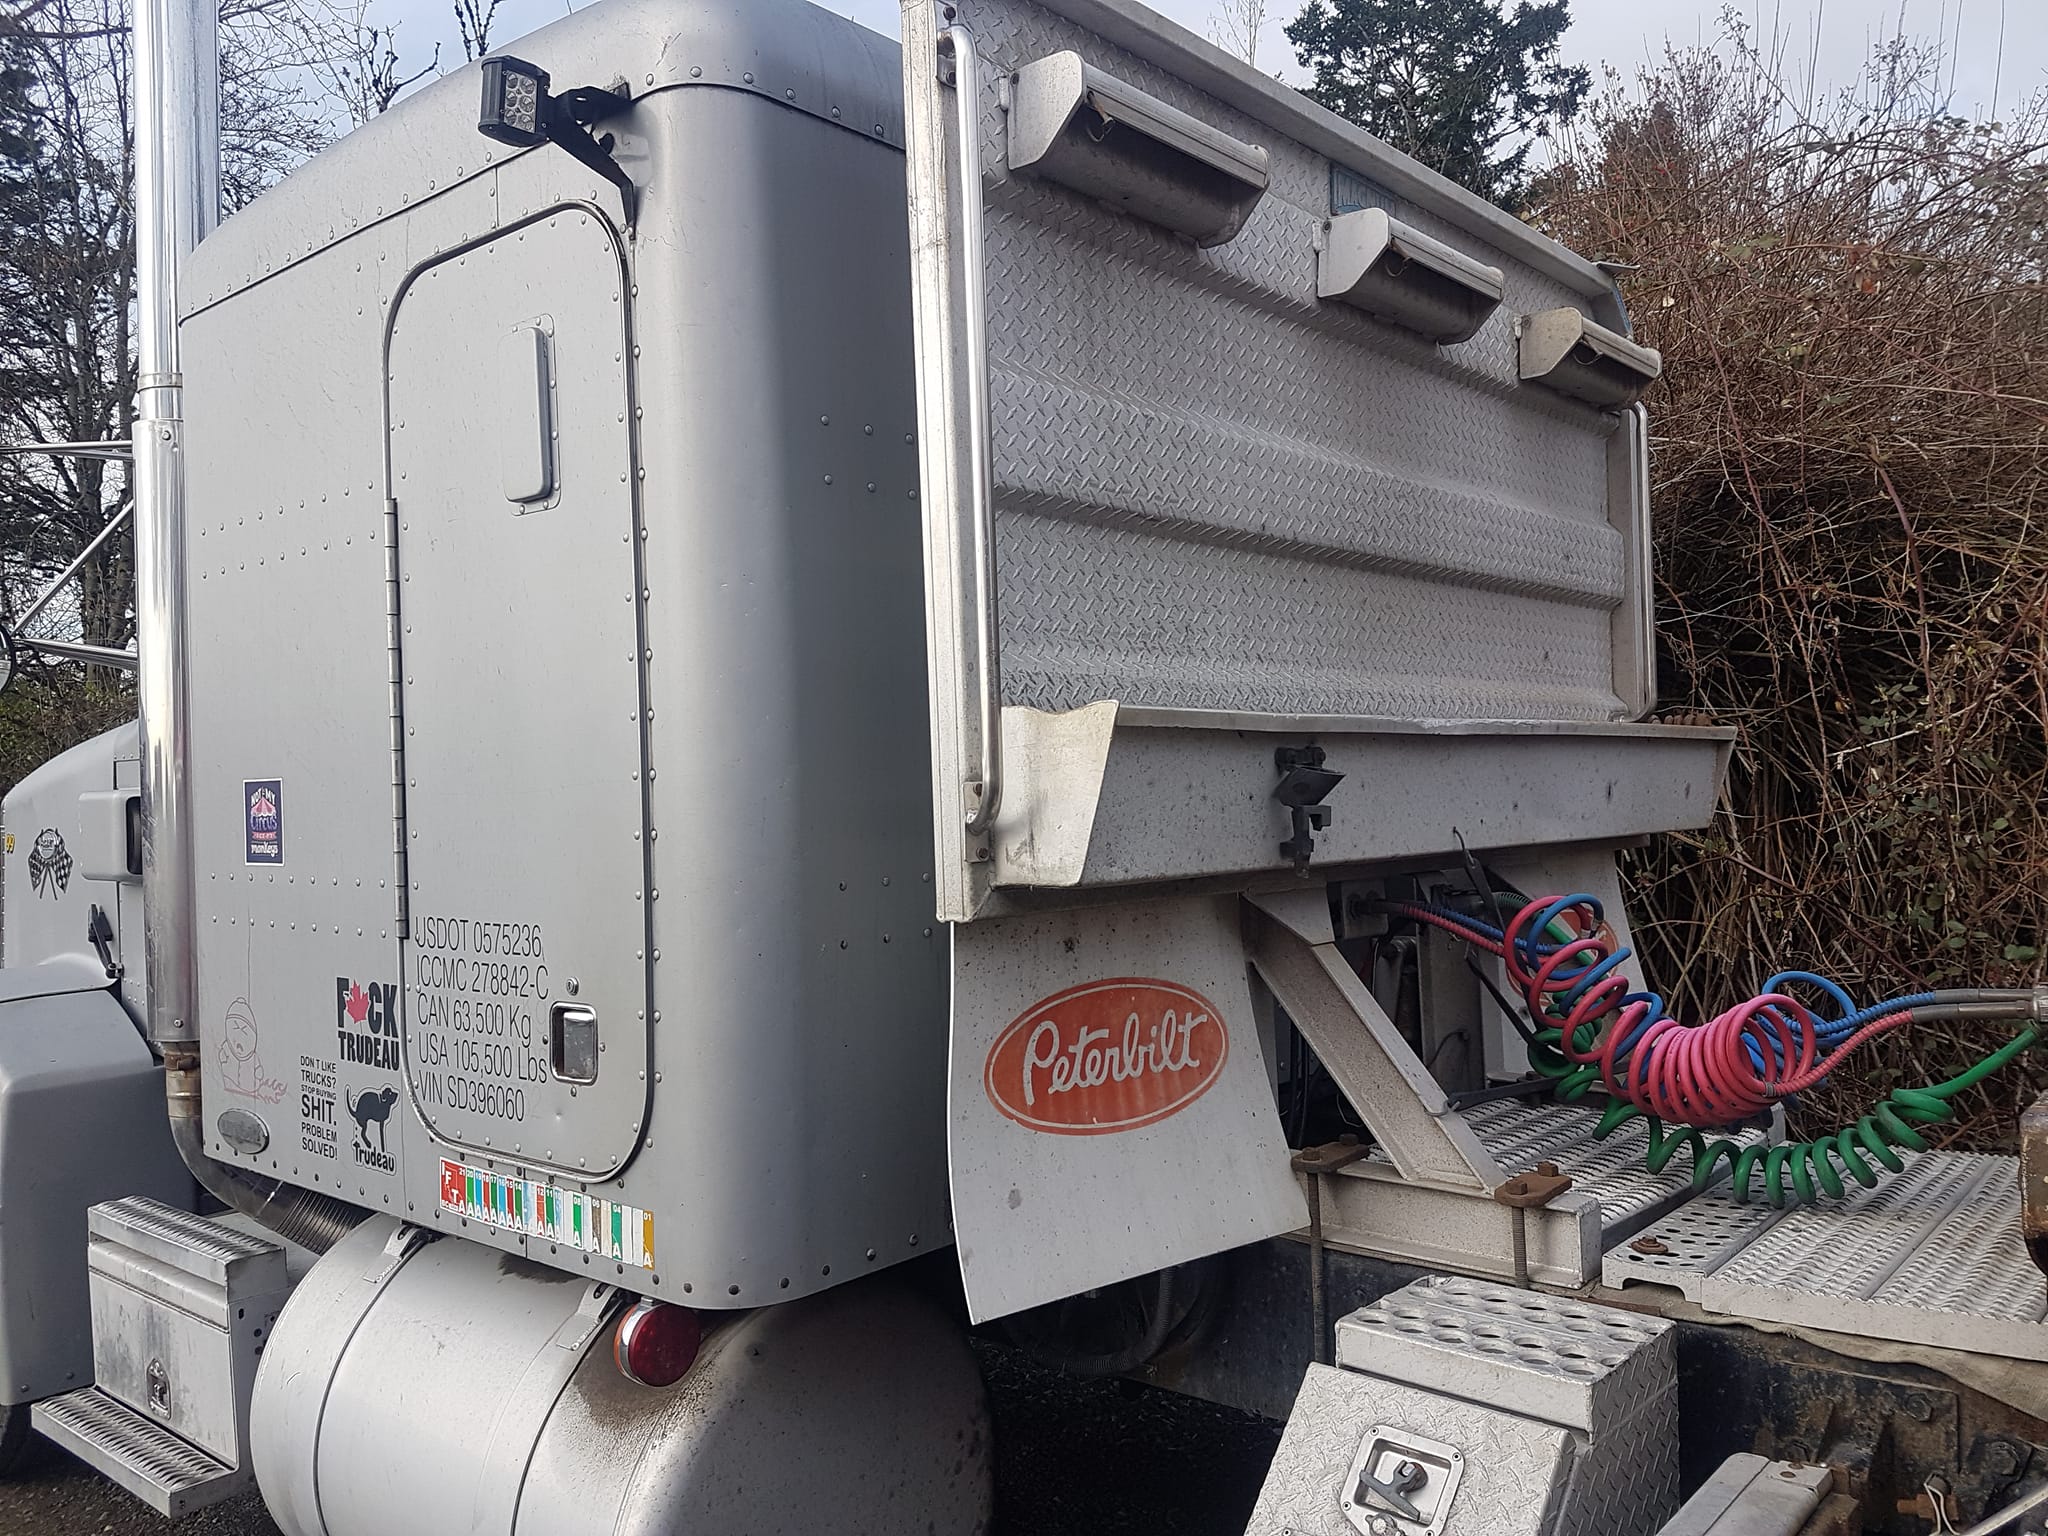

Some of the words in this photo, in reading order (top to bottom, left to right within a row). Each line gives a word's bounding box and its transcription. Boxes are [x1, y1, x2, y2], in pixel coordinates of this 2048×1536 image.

[264, 788, 277, 806] MY
[415, 916, 469, 951] USDOT
[473, 921, 542, 958] 0575236
[416, 954, 467, 992] ICCMC
[471, 961, 549, 1000] 278842-C
[336, 977, 399, 1039] FCK
[417, 992, 449, 1029] CAN
[453, 999, 504, 1038] 63,500
[509, 1004, 532, 1048] Kg
[321, 1060, 337, 1074] LIKE
[338, 1030, 400, 1072] TRUDEAU
[418, 1031, 449, 1067] USA
[453, 1038, 512, 1079] 105,500
[518, 1046, 548, 1083] Lbs
[1022, 1008, 1208, 1107] Peterbilt
[300, 1069, 337, 1089] TRUCKS?
[300, 1084, 316, 1095] STOP
[316, 1087, 337, 1101] BUYING
[418, 1069, 443, 1105] VIN
[447, 1075, 525, 1121] SD396060
[301, 1094, 338, 1126] SHIT.
[301, 1122, 338, 1143] PROBLEM
[302, 1136, 338, 1161] SOLVED!
[353, 1140, 395, 1172] Trudeau
[537, 1187, 544, 1196] 12
[545, 1189, 553, 1198] 11
[643, 1212, 652, 1221] 01
[466, 1202, 474, 1217] A
[474, 1204, 482, 1220] A
[482, 1206, 491, 1222] A
[490, 1208, 499, 1224] A
[498, 1210, 506, 1227] A
[506, 1212, 514, 1229] A
[514, 1215, 522, 1232] A
[536, 1220, 545, 1236] A
[546, 1223, 554, 1239] A
[573, 1231, 582, 1247] A
[592, 1236, 601, 1254] A
[613, 1242, 621, 1259] A
[643, 1251, 653, 1268] A
